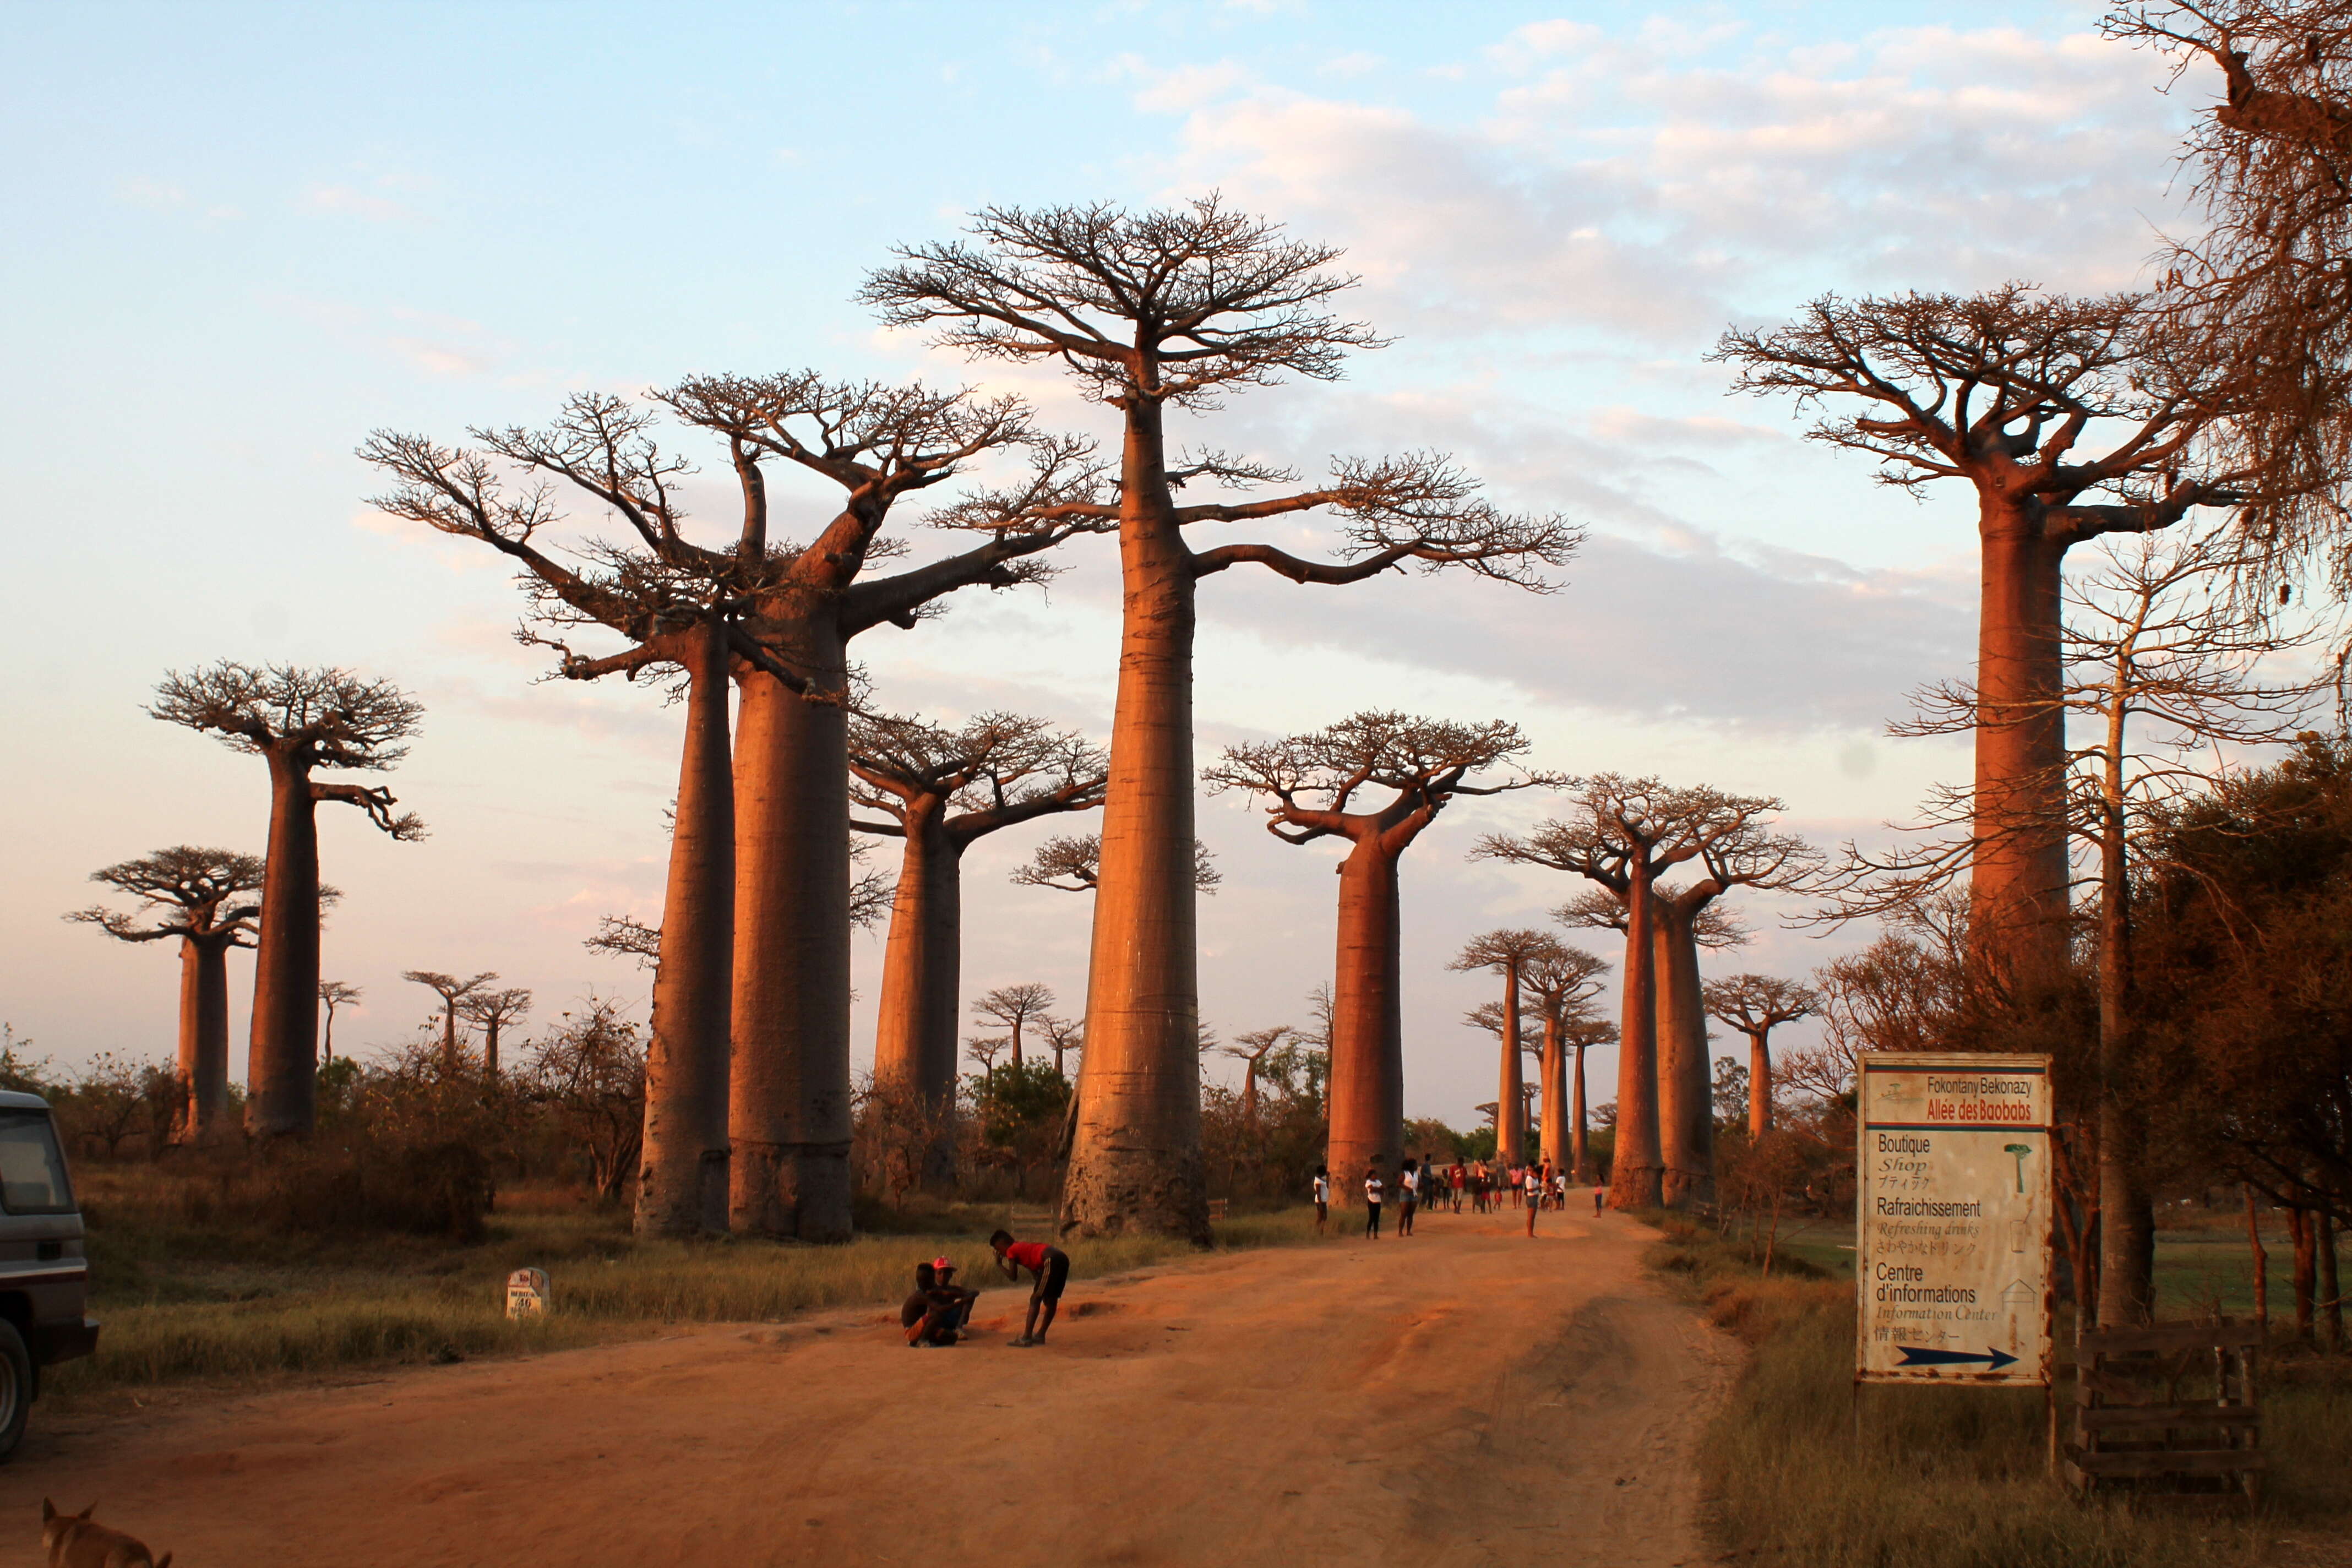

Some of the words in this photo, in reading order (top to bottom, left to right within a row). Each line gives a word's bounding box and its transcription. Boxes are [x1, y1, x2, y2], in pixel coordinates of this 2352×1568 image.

[1928, 1076, 1979, 1097] Fokontany
[1980, 1077, 2032, 1098] Bekonazy
[1927, 1098, 1955, 1120] Allée
[1958, 1099, 1978, 1120] des
[1980, 1099, 2031, 1121] Baobabs
[1879, 1134, 1930, 1157] Boutique
[1878, 1157, 1928, 1175] Shop
[1877, 1197, 1981, 1217] Rafraichissement
[1877, 1220, 1942, 1239] Refreshing
[1945, 1221, 1980, 1239] drinks
[1876, 1262, 1923, 1282] Centre
[1876, 1283, 1976, 1303] d'informations
[1876, 1305, 1952, 1323] Information
[1956, 1304, 1997, 1320] Center
